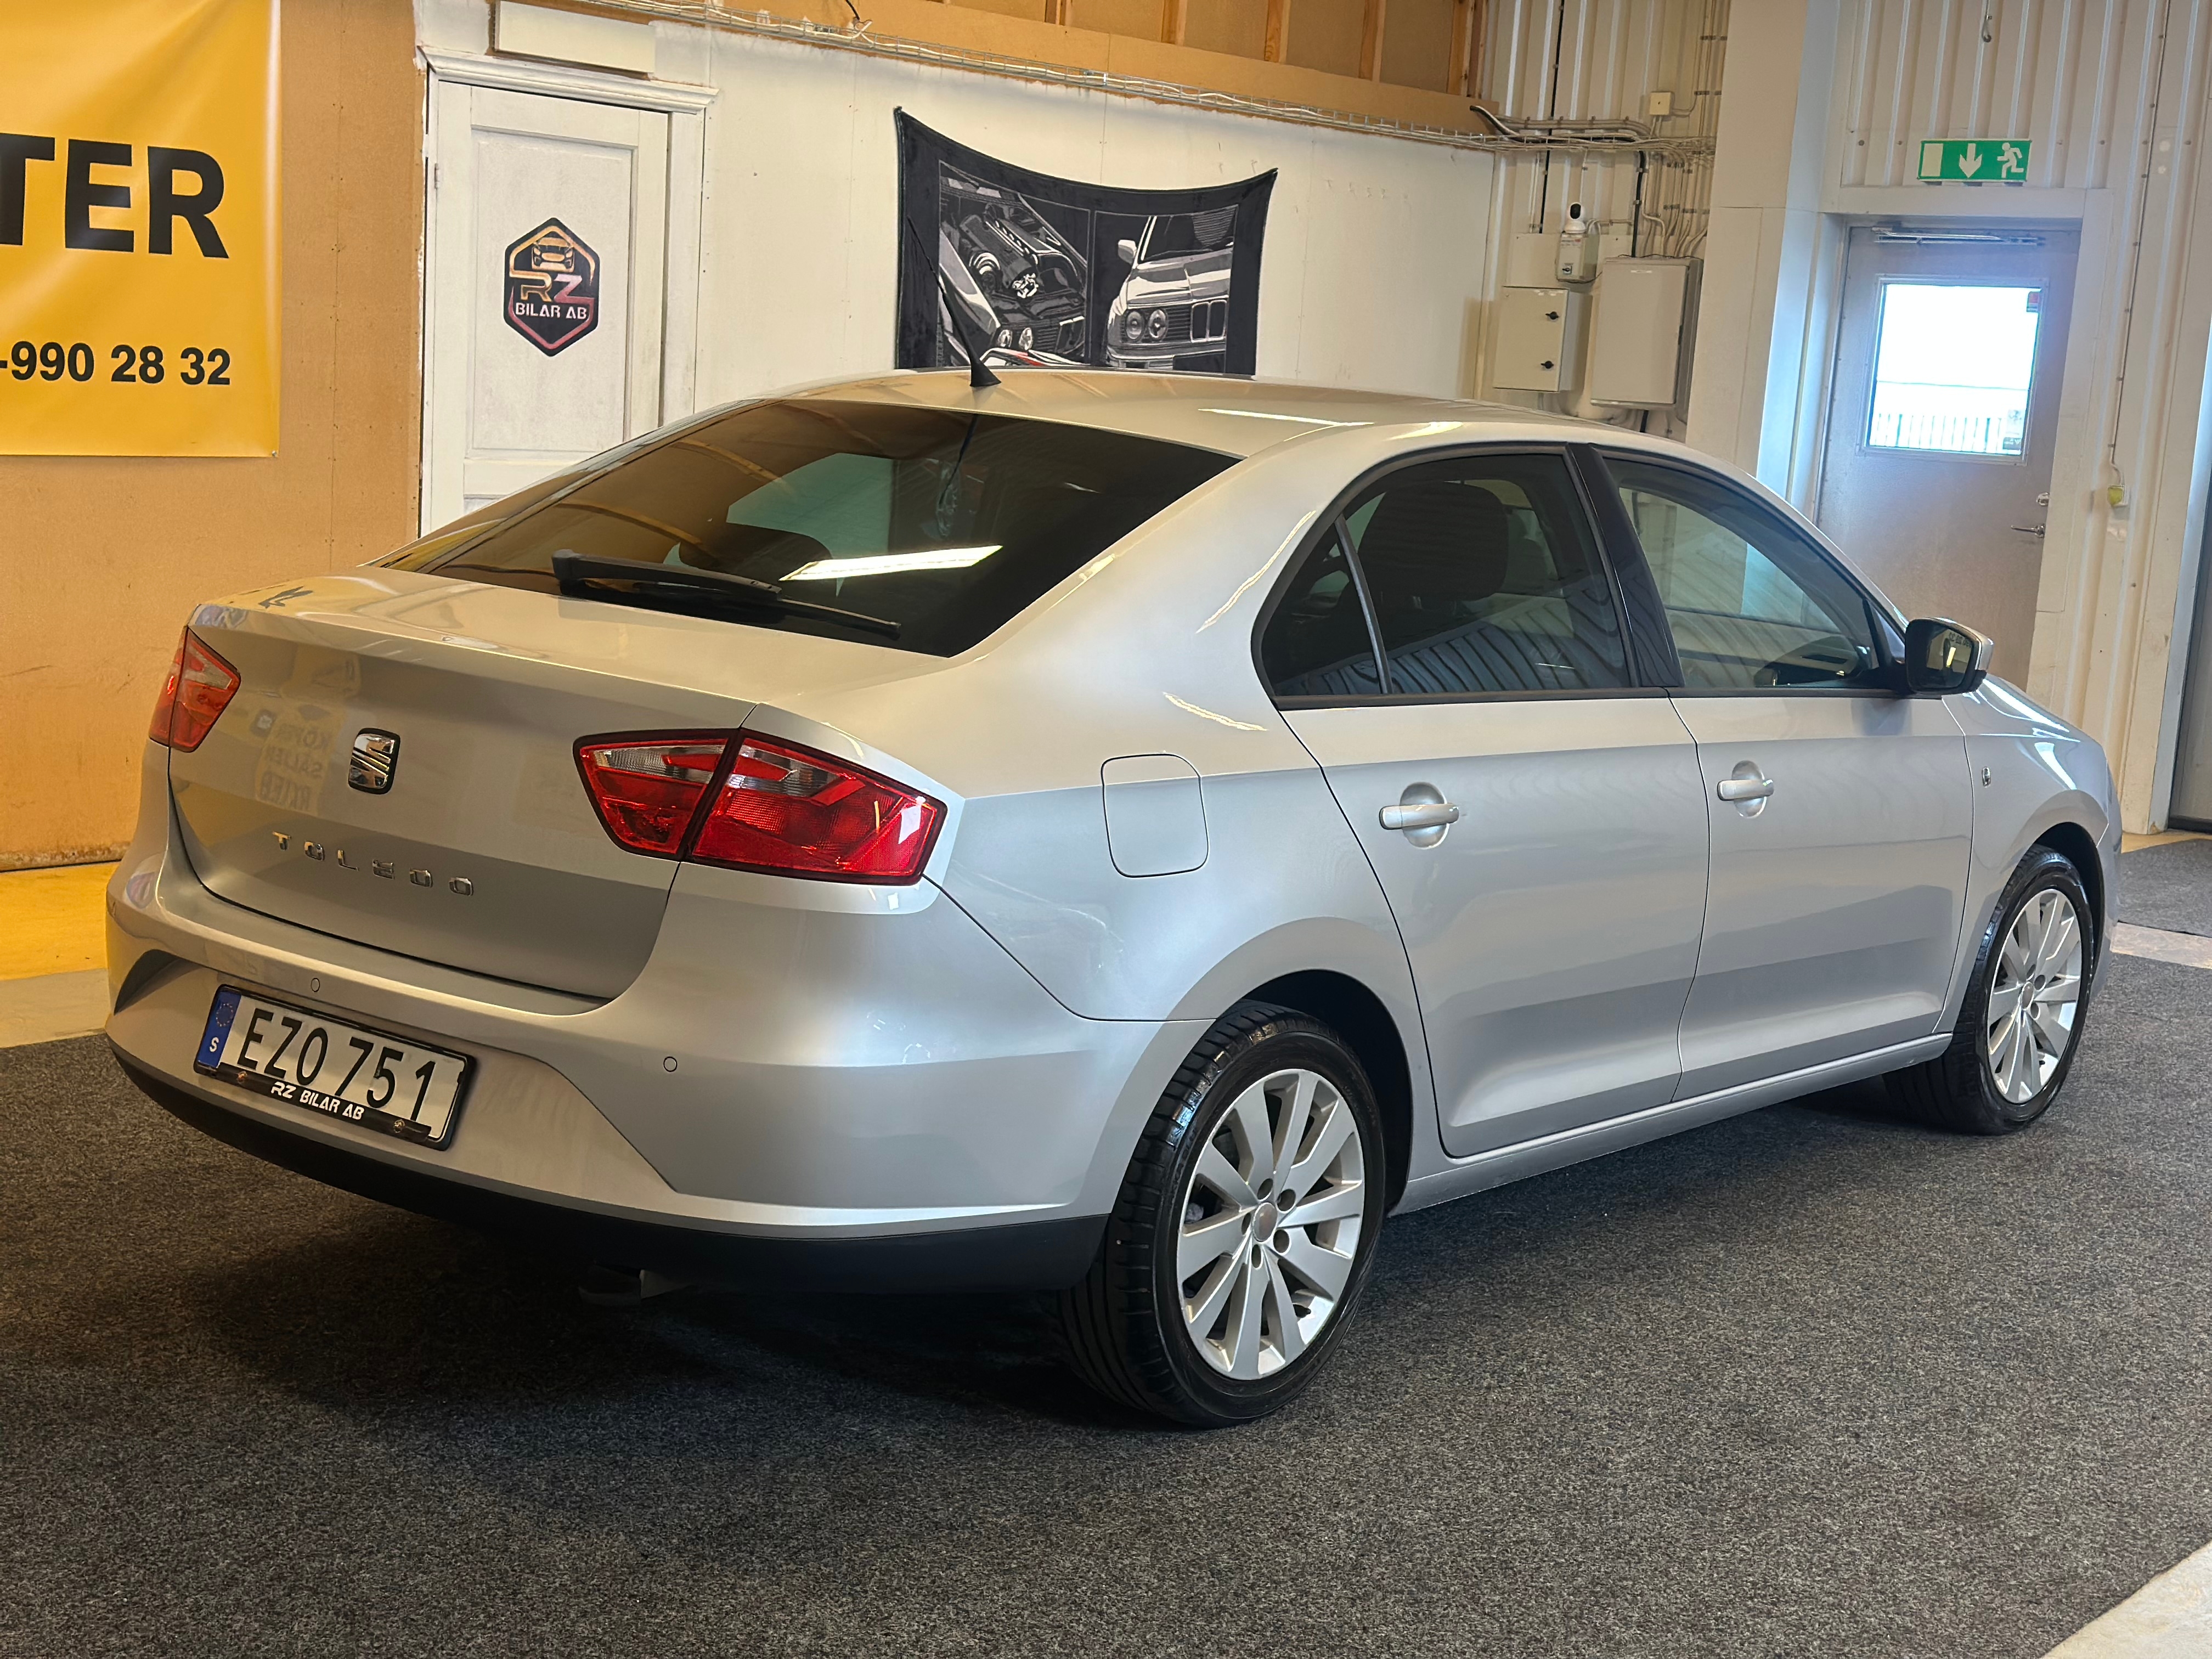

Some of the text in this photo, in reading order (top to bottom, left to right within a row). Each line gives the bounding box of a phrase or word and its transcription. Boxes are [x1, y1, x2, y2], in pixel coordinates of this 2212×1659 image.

[0, 133, 229, 259] TER
[511, 270, 594, 303] RZ
[516, 302, 587, 319] BILAR AB
[111, 345, 165, 383] 28
[180, 347, 231, 385] 32
[272, 831, 474, 896] TOLEDO
[209, 1037, 219, 1052] S
[237, 1008, 436, 1121] EZO 751
[271, 1082, 365, 1120] RZ BILAR AB
